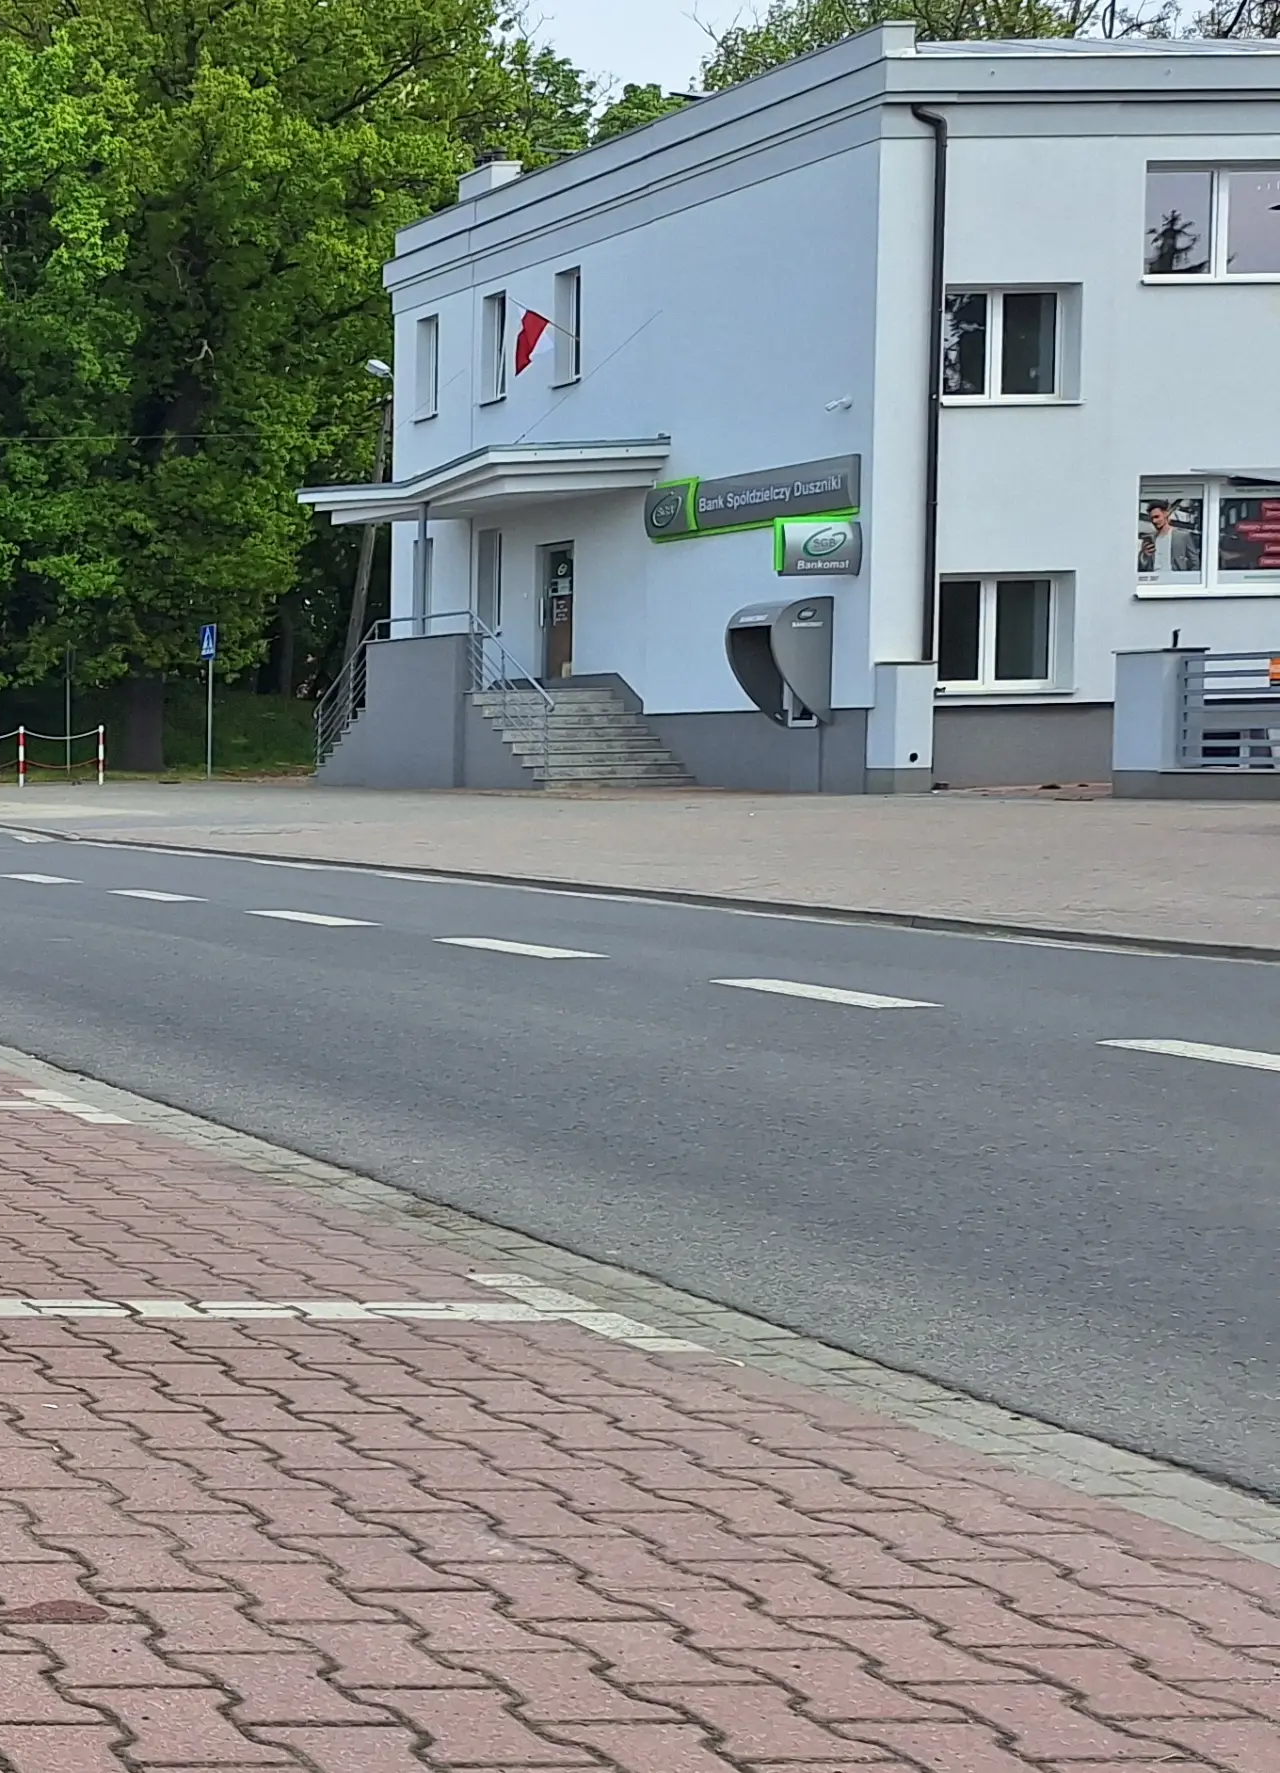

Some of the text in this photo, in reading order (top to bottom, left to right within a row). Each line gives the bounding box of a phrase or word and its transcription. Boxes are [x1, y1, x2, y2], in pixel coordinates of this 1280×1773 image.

[699, 475, 841, 513] Bank Spółdzielczy Duszniki
[813, 538, 836, 548] SGB
[797, 560, 849, 570] Bankomat
